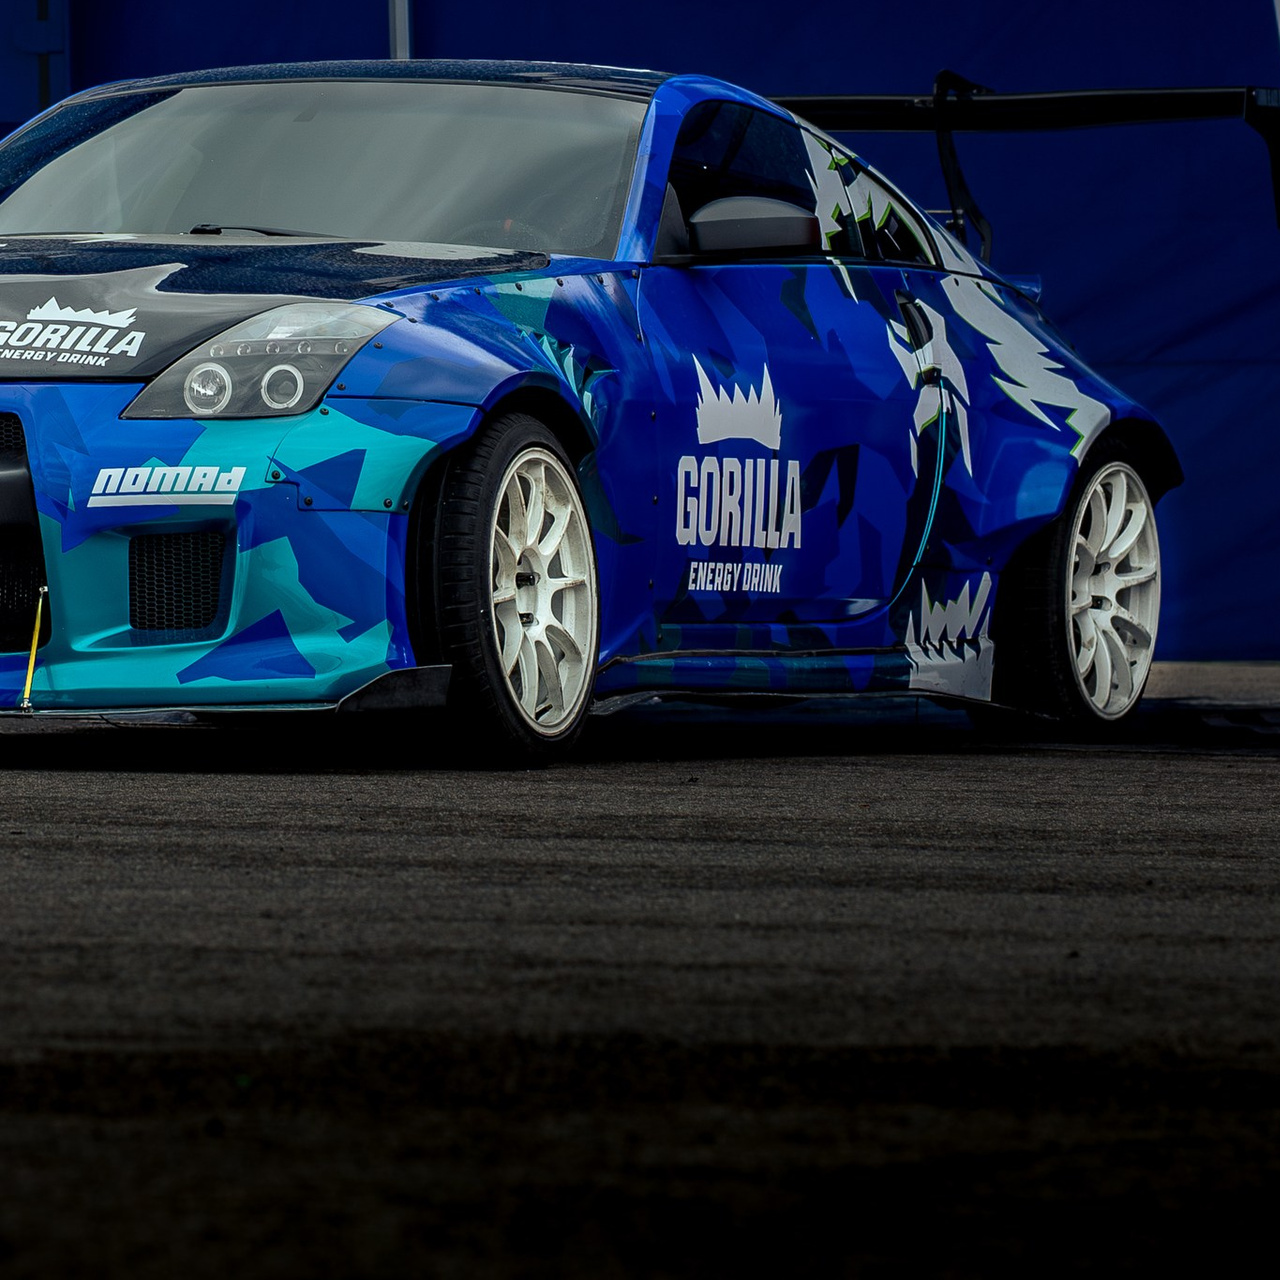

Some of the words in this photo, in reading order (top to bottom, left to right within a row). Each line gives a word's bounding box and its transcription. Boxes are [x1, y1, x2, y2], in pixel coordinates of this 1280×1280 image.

[56, 352, 111, 367] DRINK
[676, 455, 801, 549] GORILLA
[688, 561, 742, 592] ENERGY
[742, 563, 783, 593] DRINK
